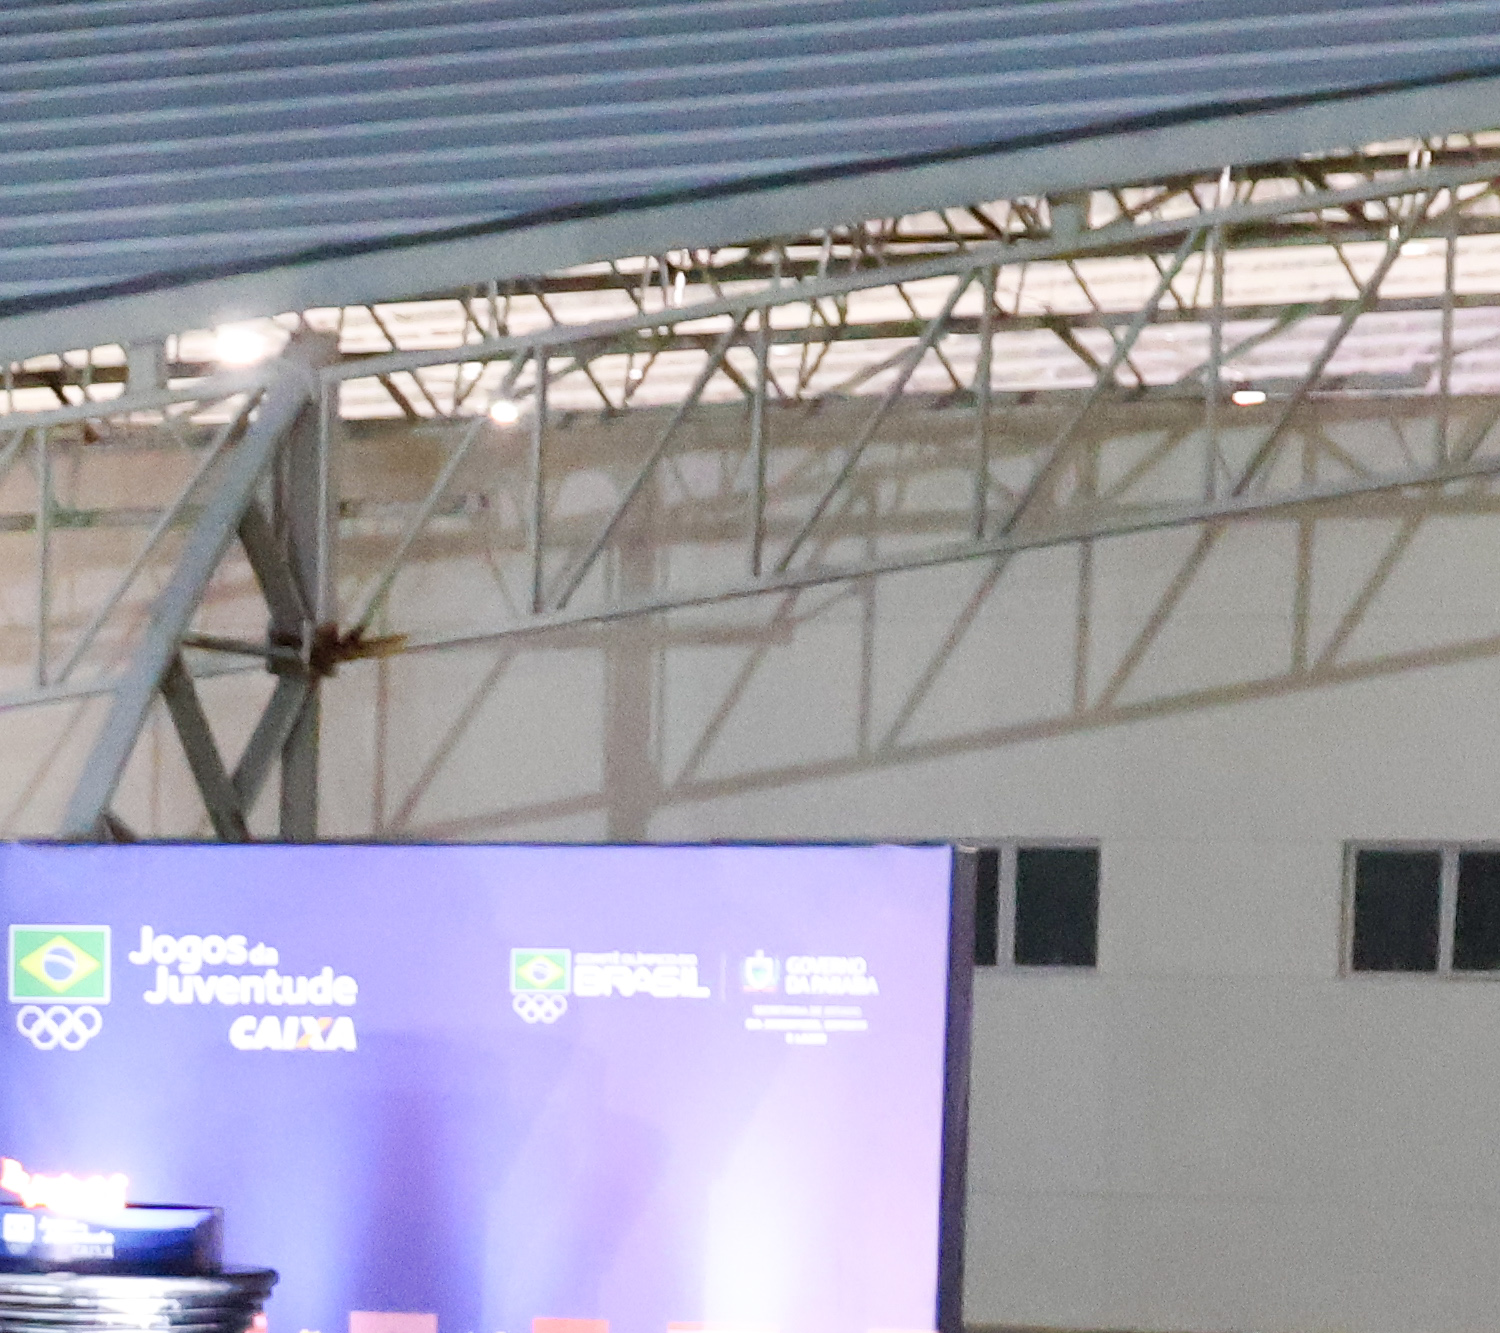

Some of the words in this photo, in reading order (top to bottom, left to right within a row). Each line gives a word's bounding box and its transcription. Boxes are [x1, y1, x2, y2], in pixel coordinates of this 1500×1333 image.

[128, 925, 248, 974] Jogos
[249, 942, 279, 966] da
[143, 965, 359, 1006] Juventude
[228, 1014, 358, 1051] CAIXA
